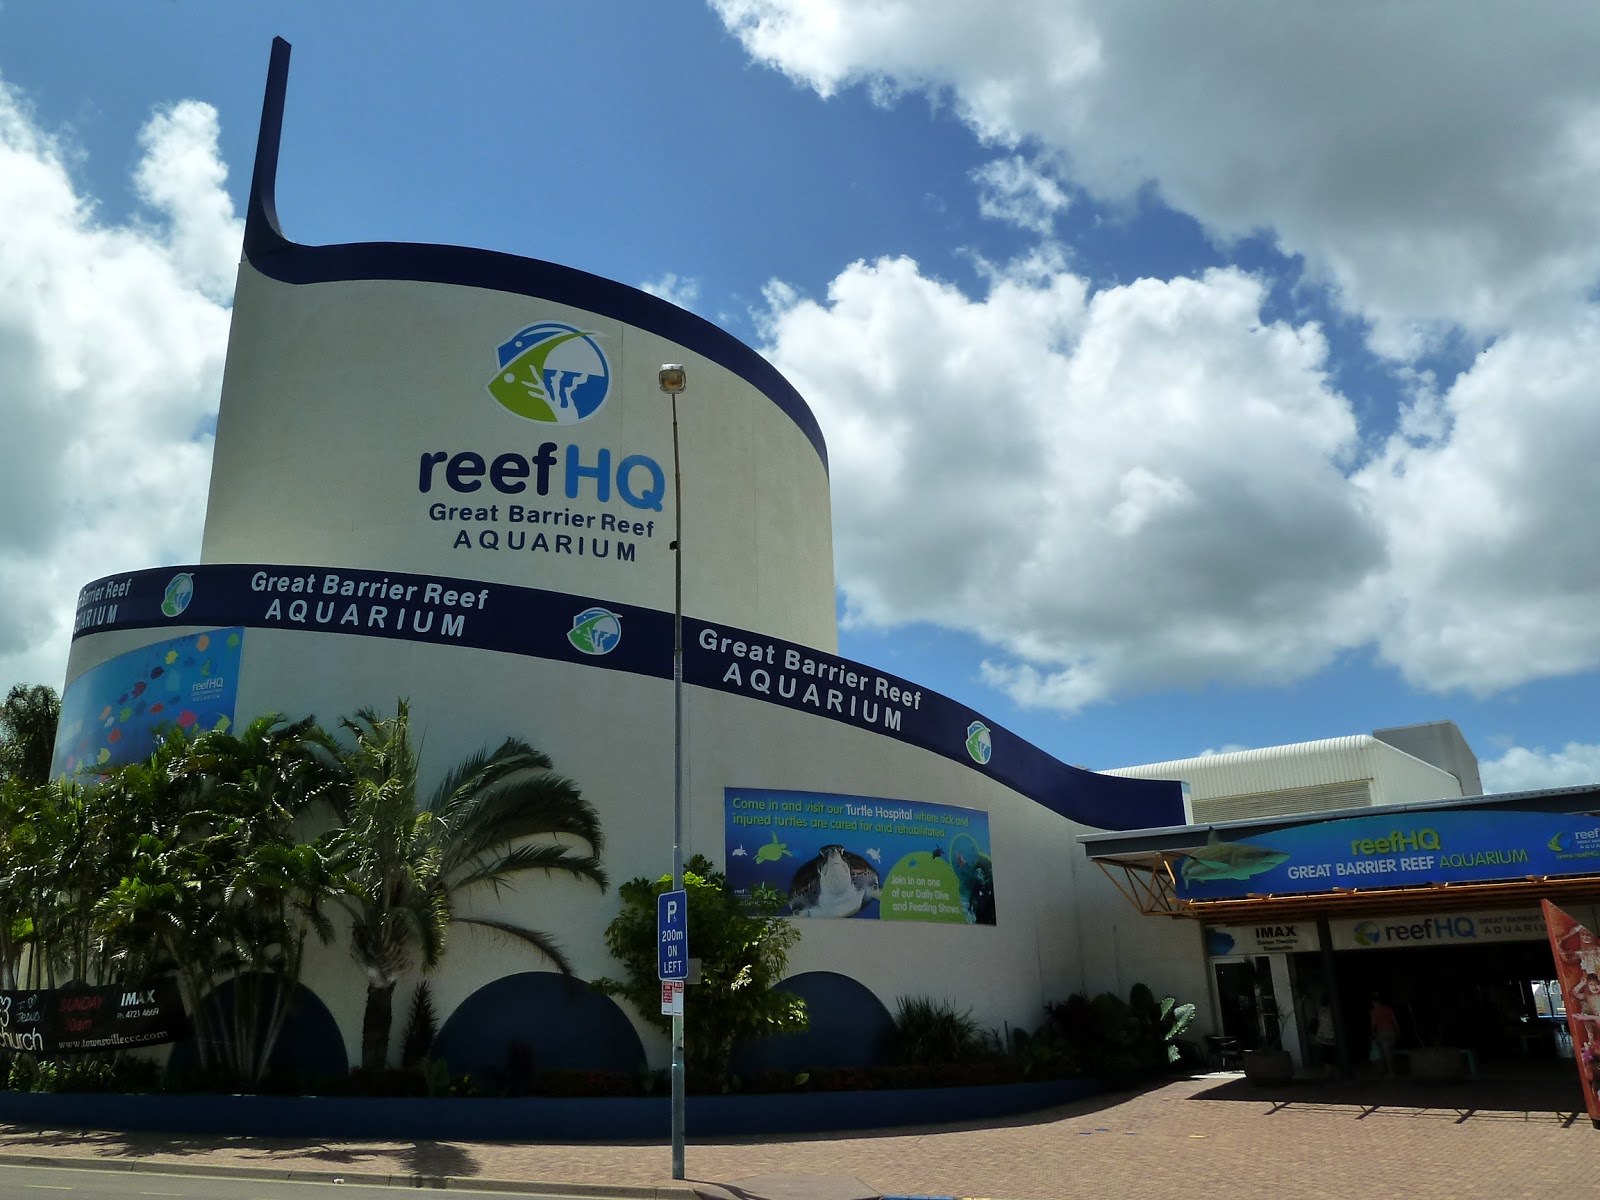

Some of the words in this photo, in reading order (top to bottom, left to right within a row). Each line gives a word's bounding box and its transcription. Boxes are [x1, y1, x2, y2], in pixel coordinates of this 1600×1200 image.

[419, 442, 665, 512] reefHQ
[429, 502, 498, 521] Great
[509, 505, 595, 528] Barrier
[601, 513, 654, 538] Reef
[453, 530, 635, 562] AQUARIUM
[105, 578, 132, 599] Reef
[251, 571, 315, 594] Great
[323, 574, 416, 601] Barrier
[424, 583, 490, 610] Reef
[265, 599, 466, 637] AQUARIUM
[699, 629, 774, 664] Great
[784, 650, 868, 691] Barrier
[875, 677, 921, 710] Reef
[193, 678, 223, 690] reefHQ
[723, 662, 902, 731] AQUARIUM
[733, 798, 765, 809] Come
[769, 800, 778, 810] in
[782, 801, 802, 811] and
[805, 802, 825, 813] visit
[828, 806, 844, 815] our
[845, 804, 873, 817] Turtle
[876, 806, 912, 821] Hospital
[915, 811, 939, 823] where
[941, 813, 952, 823] sick
[955, 816, 969, 826] and
[733, 813, 771, 827] injured
[775, 816, 808, 827] turtles
[812, 820, 827, 828] are
[830, 820, 858, 830] cared
[860, 821, 873, 831] for
[876, 823, 892, 833] and
[1351, 829, 1441, 856] reefHQ
[1288, 863, 1331, 879] GREAT
[1336, 859, 1397, 875] BARRIER
[1400, 856, 1435, 871] REEF
[1440, 848, 1528, 868] AQUARIUM
[891, 875, 906, 885] Join
[908, 875, 915, 885] in
[917, 878, 925, 886] on
[927, 879, 941, 887] one
[892, 888, 899, 897] of
[916, 888, 933, 901] Daily
[935, 890, 949, 900] Dive
[667, 901, 677, 923] P
[892, 902, 907, 911] and
[909, 902, 937, 914] Feeding
[1386, 917, 1477, 941] reefHQ
[1479, 917, 1504, 925] GREAT
[1506, 914, 1540, 923] BARRIER
[1485, 923, 1547, 934] AQUARIU
[662, 929, 683, 942] 200m
[1256, 925, 1297, 938] IMAX
[668, 945, 678, 957] ON
[663, 960, 682, 974] LEFT
[60, 995, 104, 1012] SUNDAY
[121, 989, 155, 1007] IMAX
[126, 1009, 140, 1018] 4721
[142, 1007, 159, 1017] 4669
[65, 1017, 94, 1032] 10am
[58, 1030, 168, 1049] www.townsvilleccc.com
